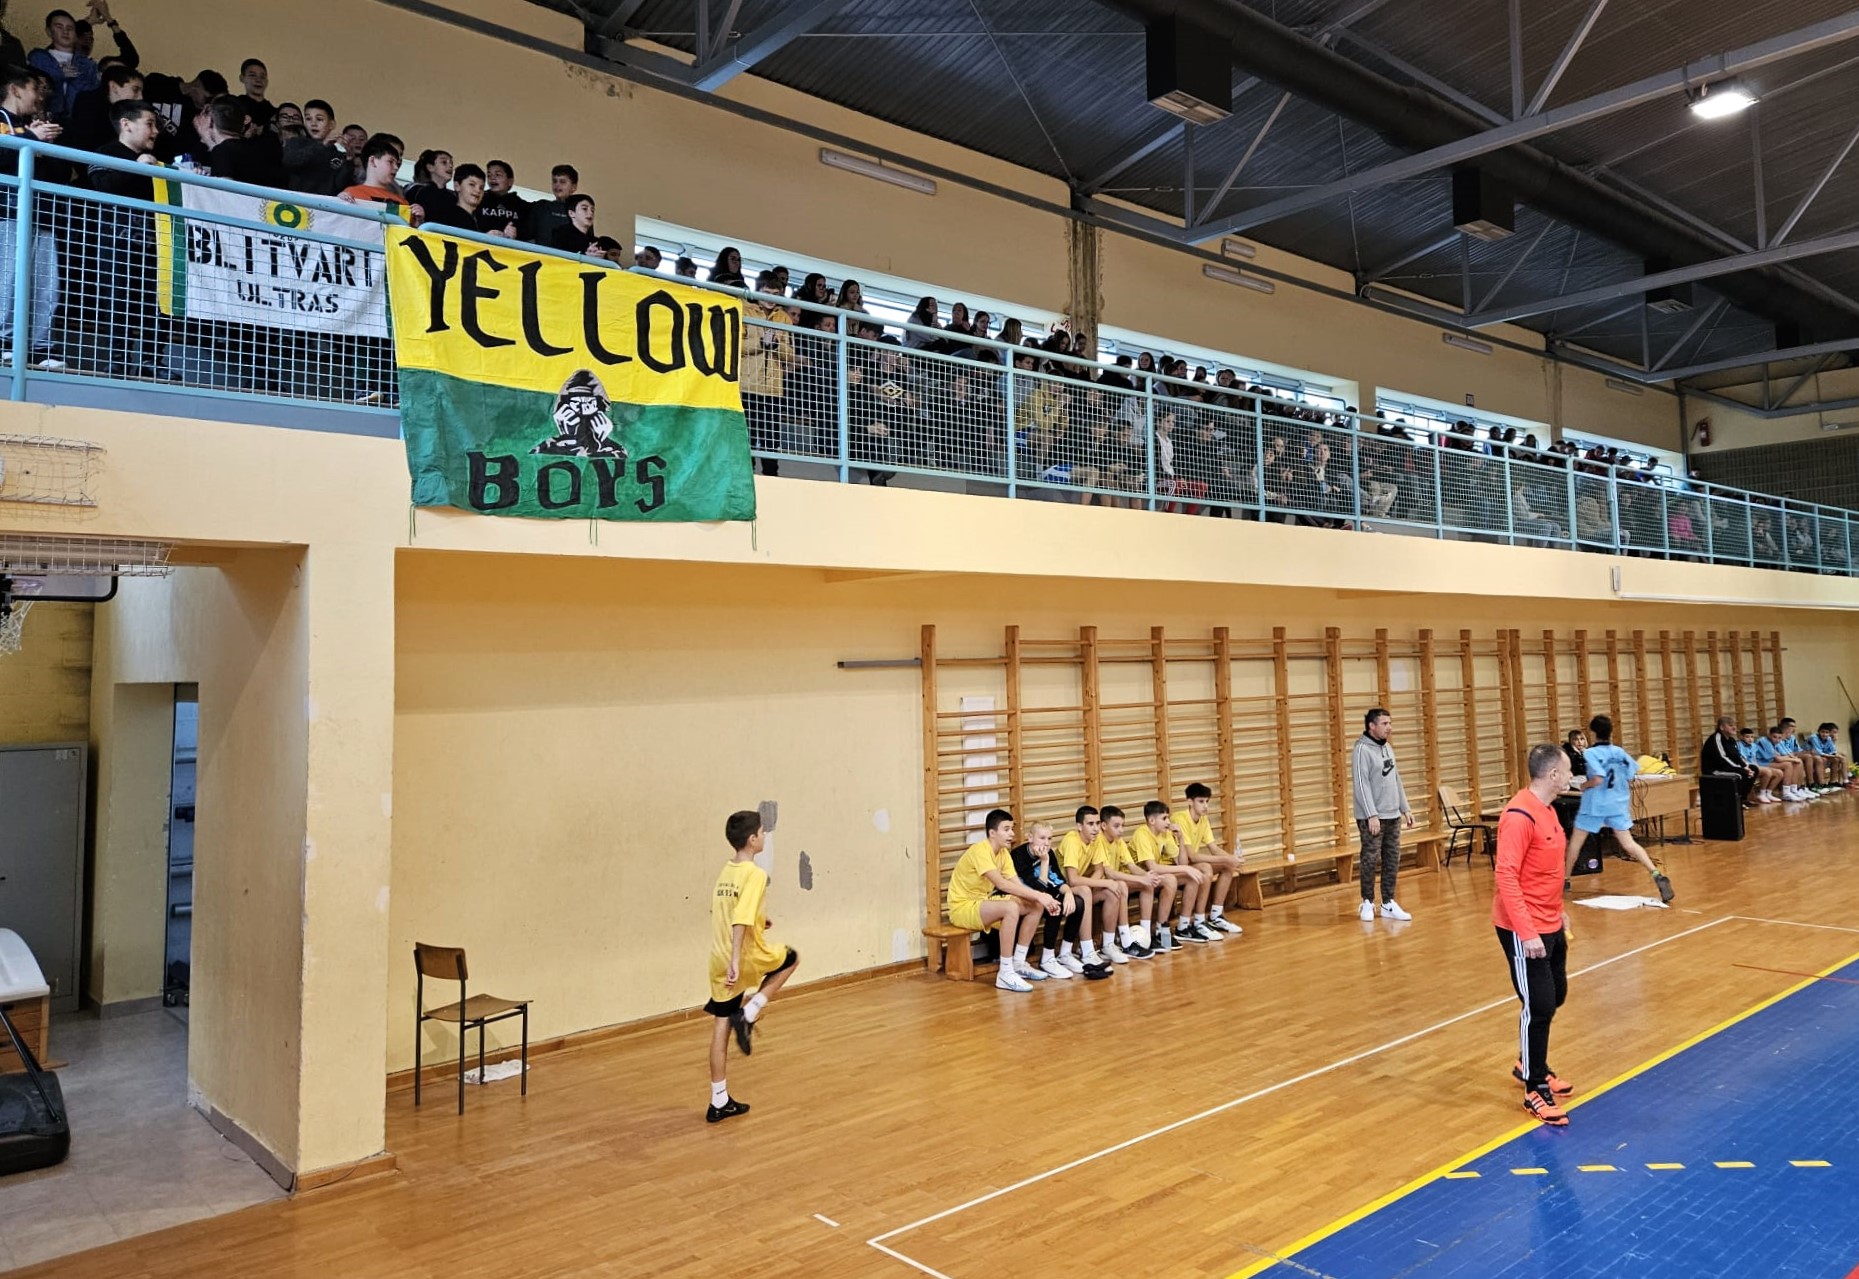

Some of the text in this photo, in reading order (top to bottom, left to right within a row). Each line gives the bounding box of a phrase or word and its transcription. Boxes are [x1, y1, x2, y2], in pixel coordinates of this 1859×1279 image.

[482, 208, 519, 219] KAPPA
[238, 280, 338, 313] ULTRAS
[400, 236, 739, 381] YELLOW
[468, 452, 666, 512] BOYS
[1607, 768, 1615, 788] 2
